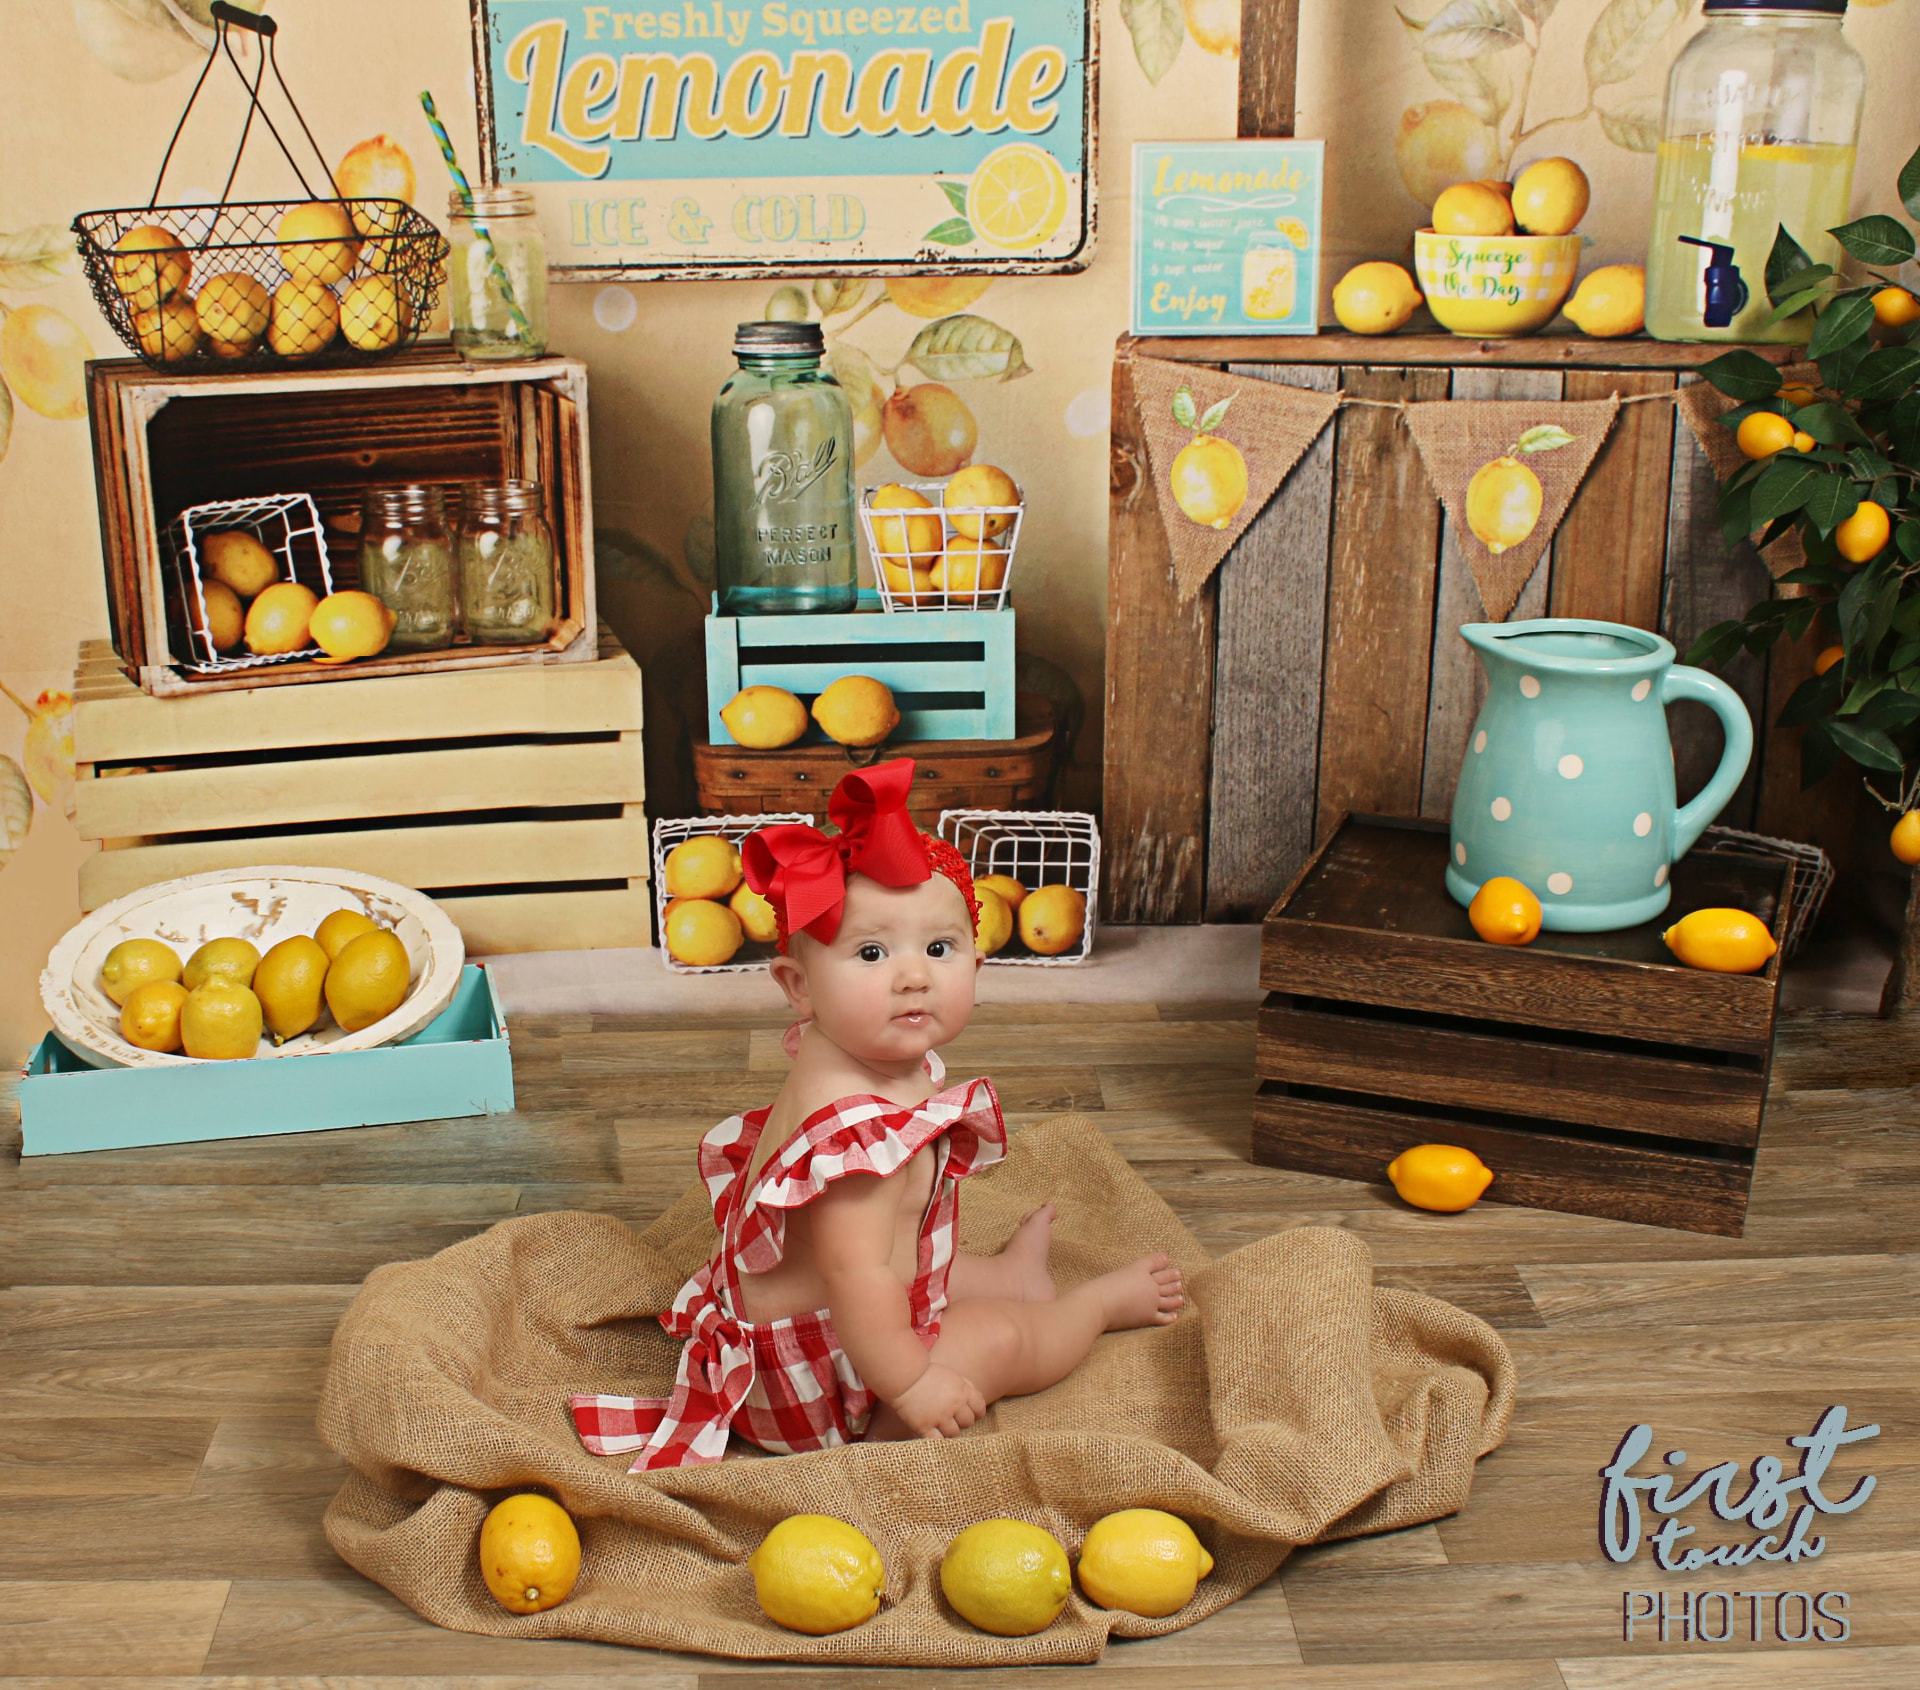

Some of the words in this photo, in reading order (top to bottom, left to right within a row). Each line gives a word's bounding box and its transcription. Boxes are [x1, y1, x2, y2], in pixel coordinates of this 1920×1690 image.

[583, 1, 752, 47] Freshly
[762, 0, 972, 45] Squeezed
[505, 17, 1068, 180] Lemonade
[1152, 155, 1312, 197] Lemonade
[568, 197, 648, 246] ICE
[667, 196, 713, 245] &
[732, 194, 867, 243] COLD
[1449, 239, 1524, 273] Squeeze
[1150, 281, 1227, 322] Enjoy
[1482, 277, 1522, 306] Day
[749, 436, 838, 512] Ball
[757, 523, 838, 542] PERFECT
[765, 547, 832, 566] MASON
